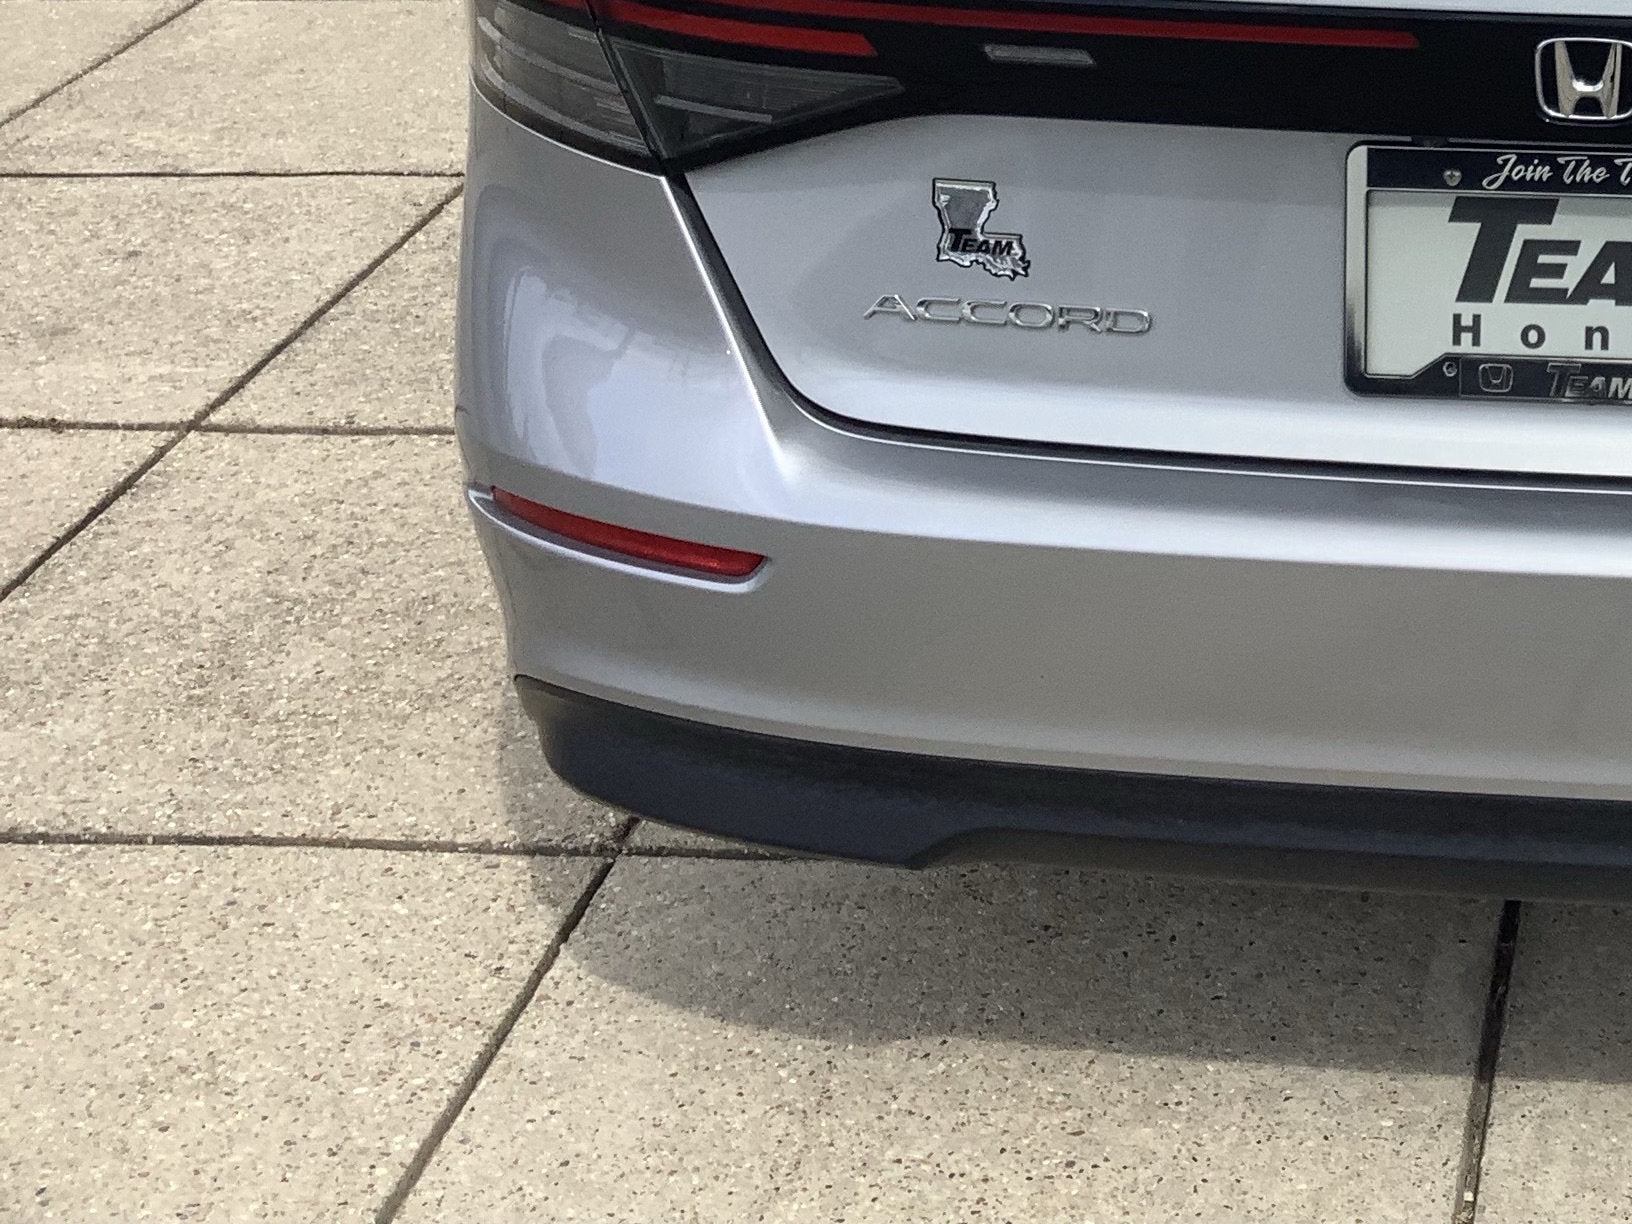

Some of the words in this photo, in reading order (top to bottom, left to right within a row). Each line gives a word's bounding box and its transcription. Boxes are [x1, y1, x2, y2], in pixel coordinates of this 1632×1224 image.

[1482, 153, 1553, 190] Join
[1556, 156, 1610, 185] The
[949, 227, 1014, 255] TEAM
[863, 294, 1152, 334] ACCORD
